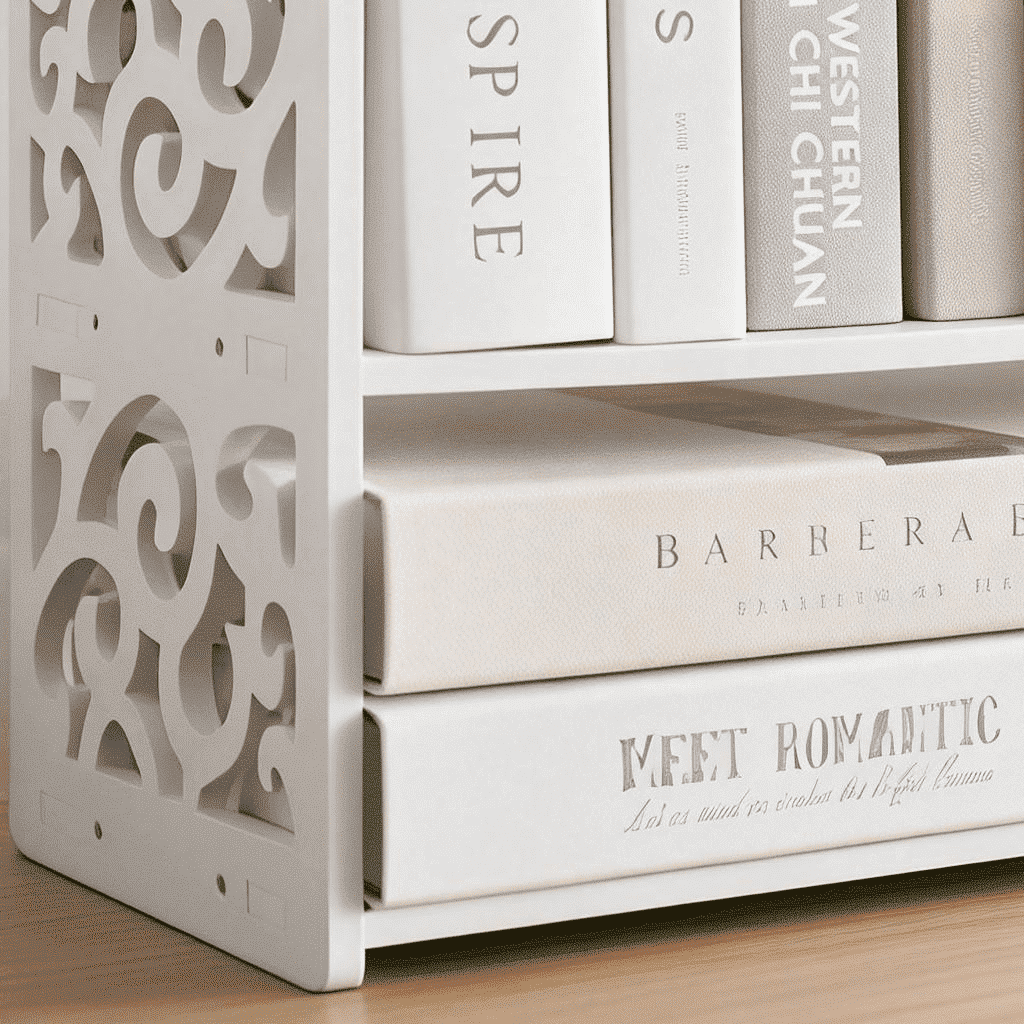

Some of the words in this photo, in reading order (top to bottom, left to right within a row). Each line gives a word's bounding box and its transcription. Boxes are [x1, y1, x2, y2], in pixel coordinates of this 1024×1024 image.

[788, 28, 822, 112] CHI
[826, 1, 863, 230] WESTERN
[790, 130, 828, 309] CHUAN
[655, 511, 975, 569] BARBERA
[619, 726, 749, 793] MEET
